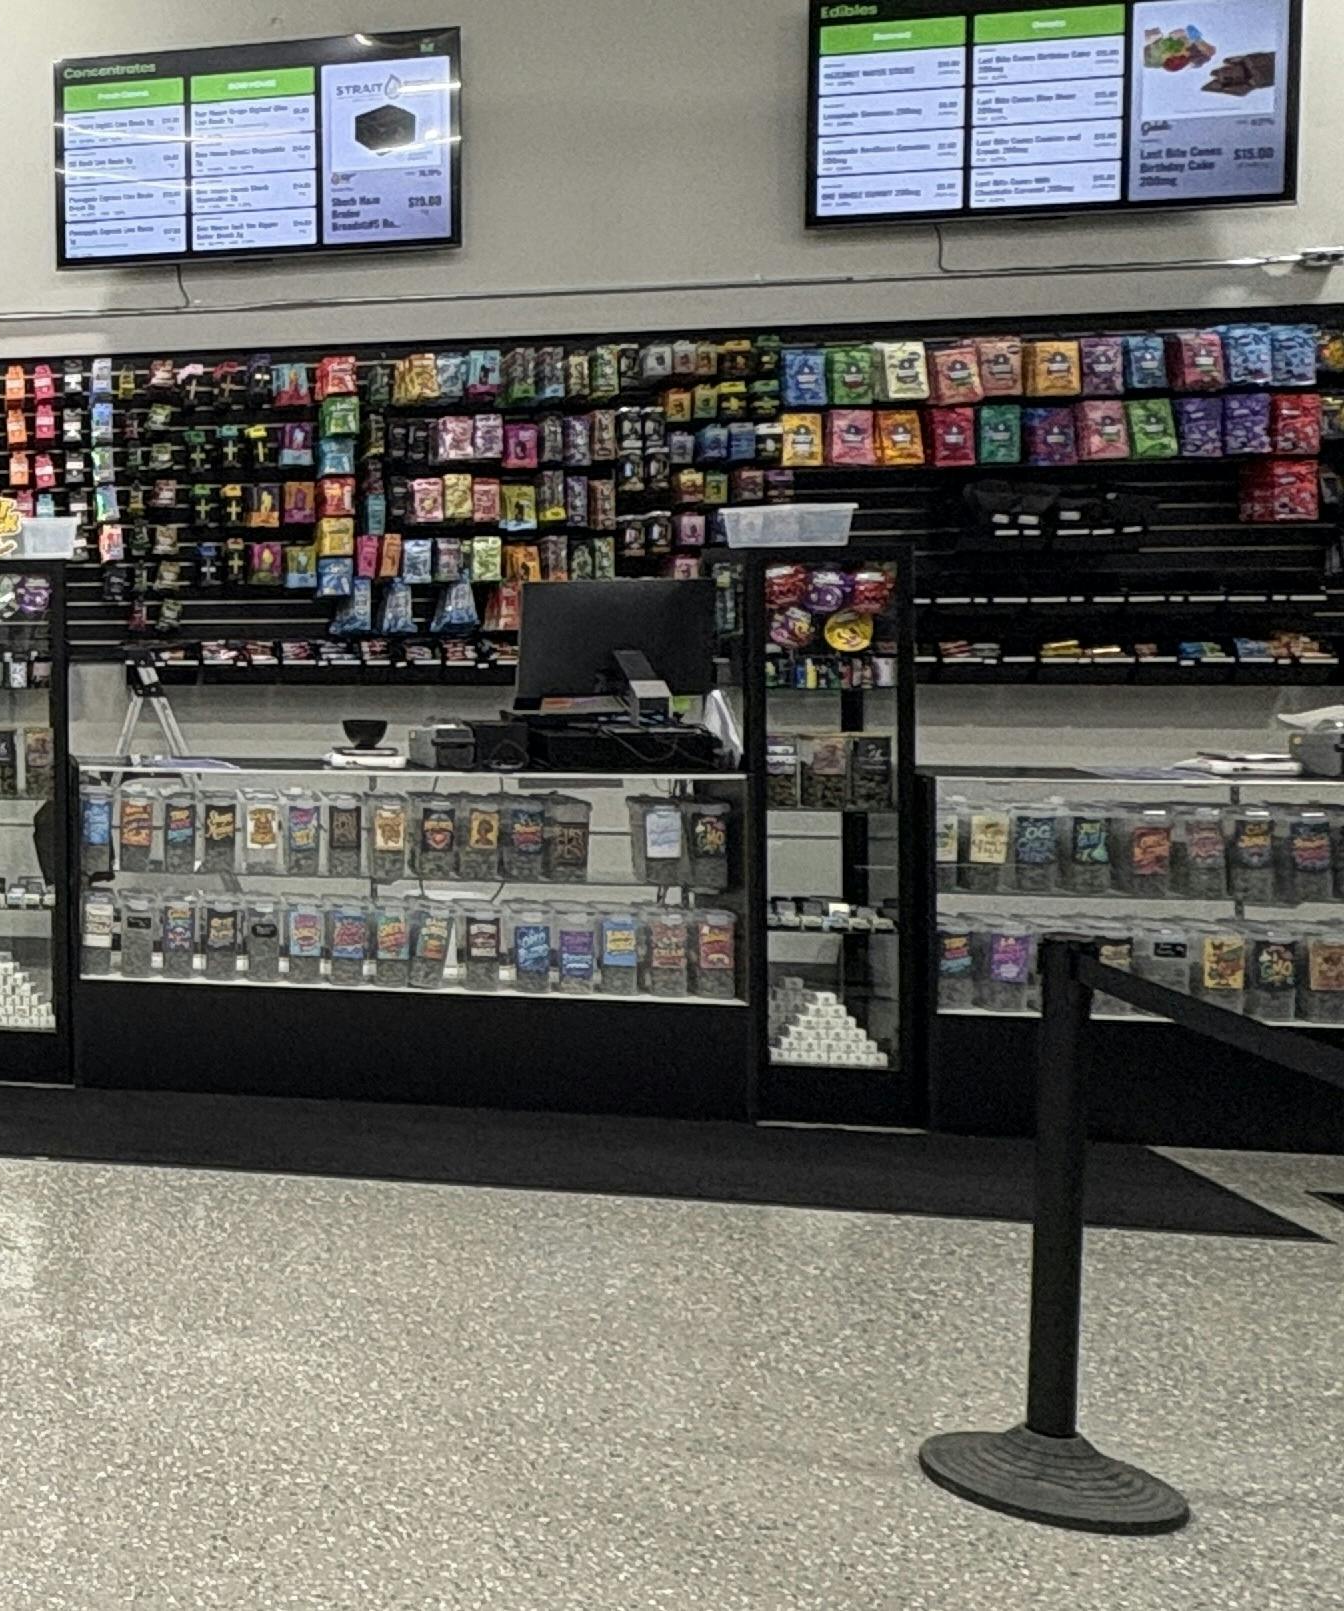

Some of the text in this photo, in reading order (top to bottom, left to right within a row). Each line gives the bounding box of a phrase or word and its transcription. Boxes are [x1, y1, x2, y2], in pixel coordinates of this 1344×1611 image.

[820, 4, 878, 19] Edibles
[63, 63, 156, 79] Concentrates
[335, 83, 383, 97] STRAIT
